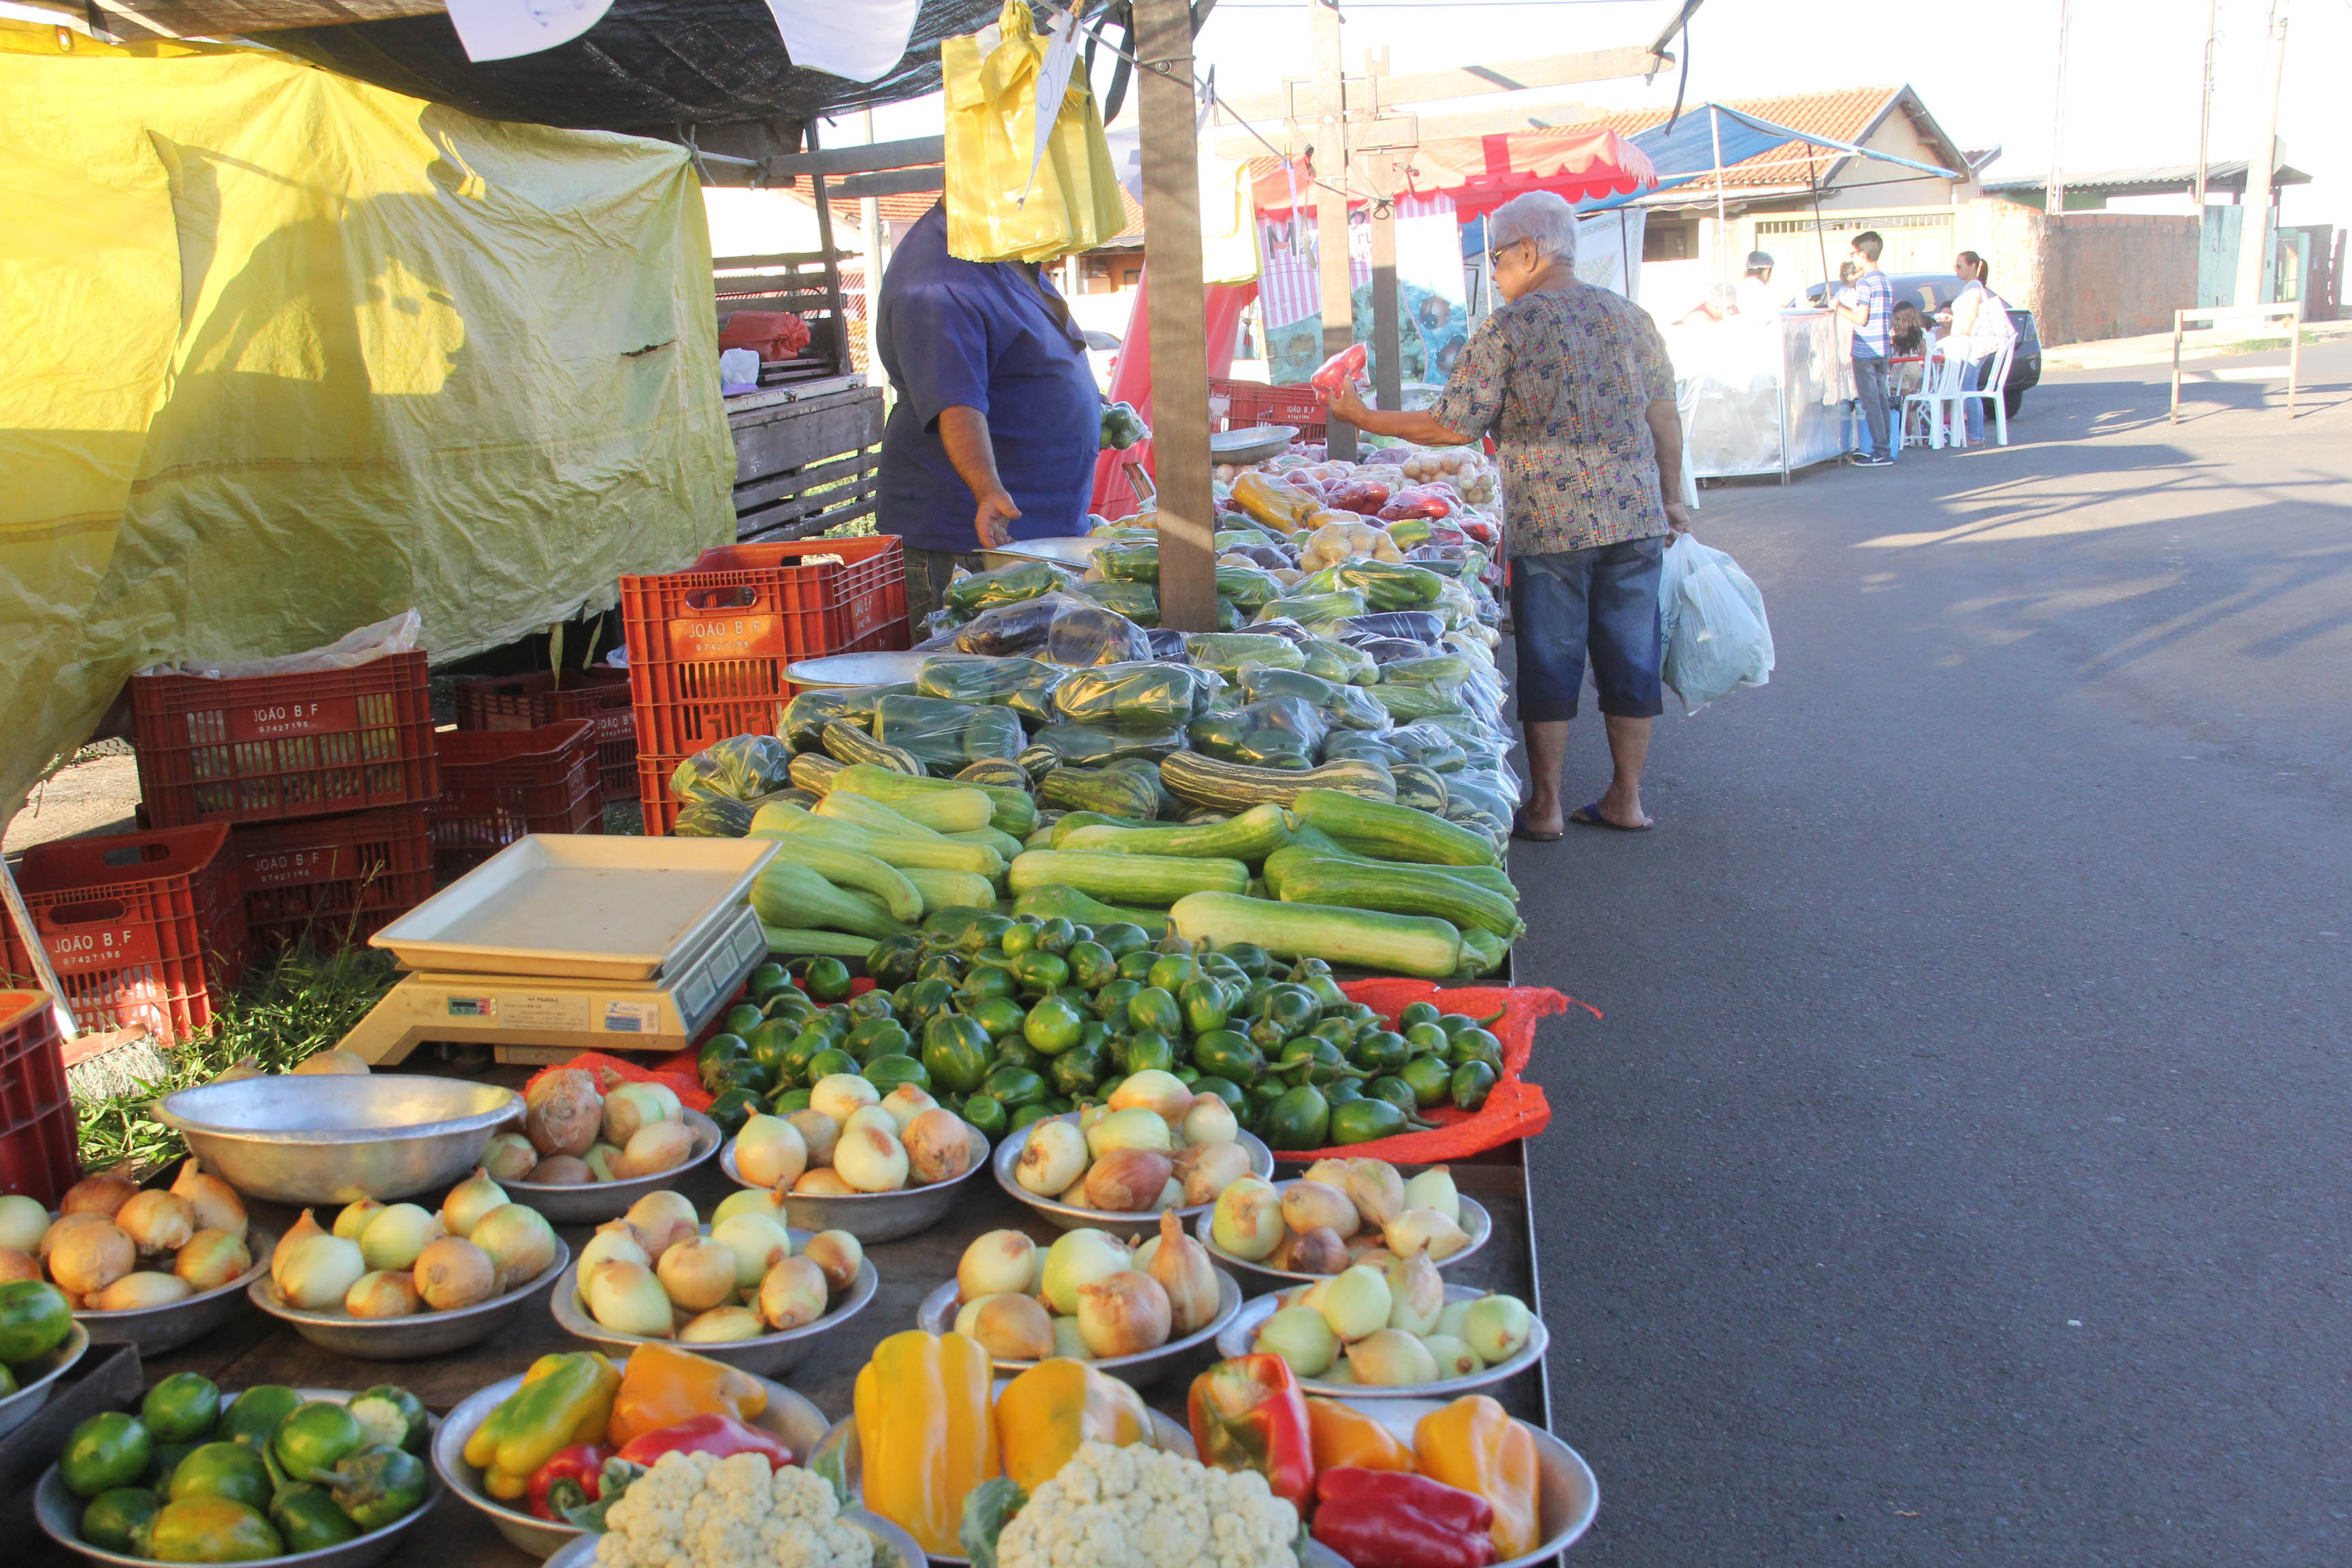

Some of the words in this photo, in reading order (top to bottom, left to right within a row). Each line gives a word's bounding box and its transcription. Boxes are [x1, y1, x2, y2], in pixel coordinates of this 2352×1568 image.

[689, 621, 725, 638] JOÃO
[254, 707, 285, 722] JOÃO
[259, 721, 309, 733] 97427195
[55, 935, 93, 953] JOÃO
[63, 951, 120, 964] 97427195
